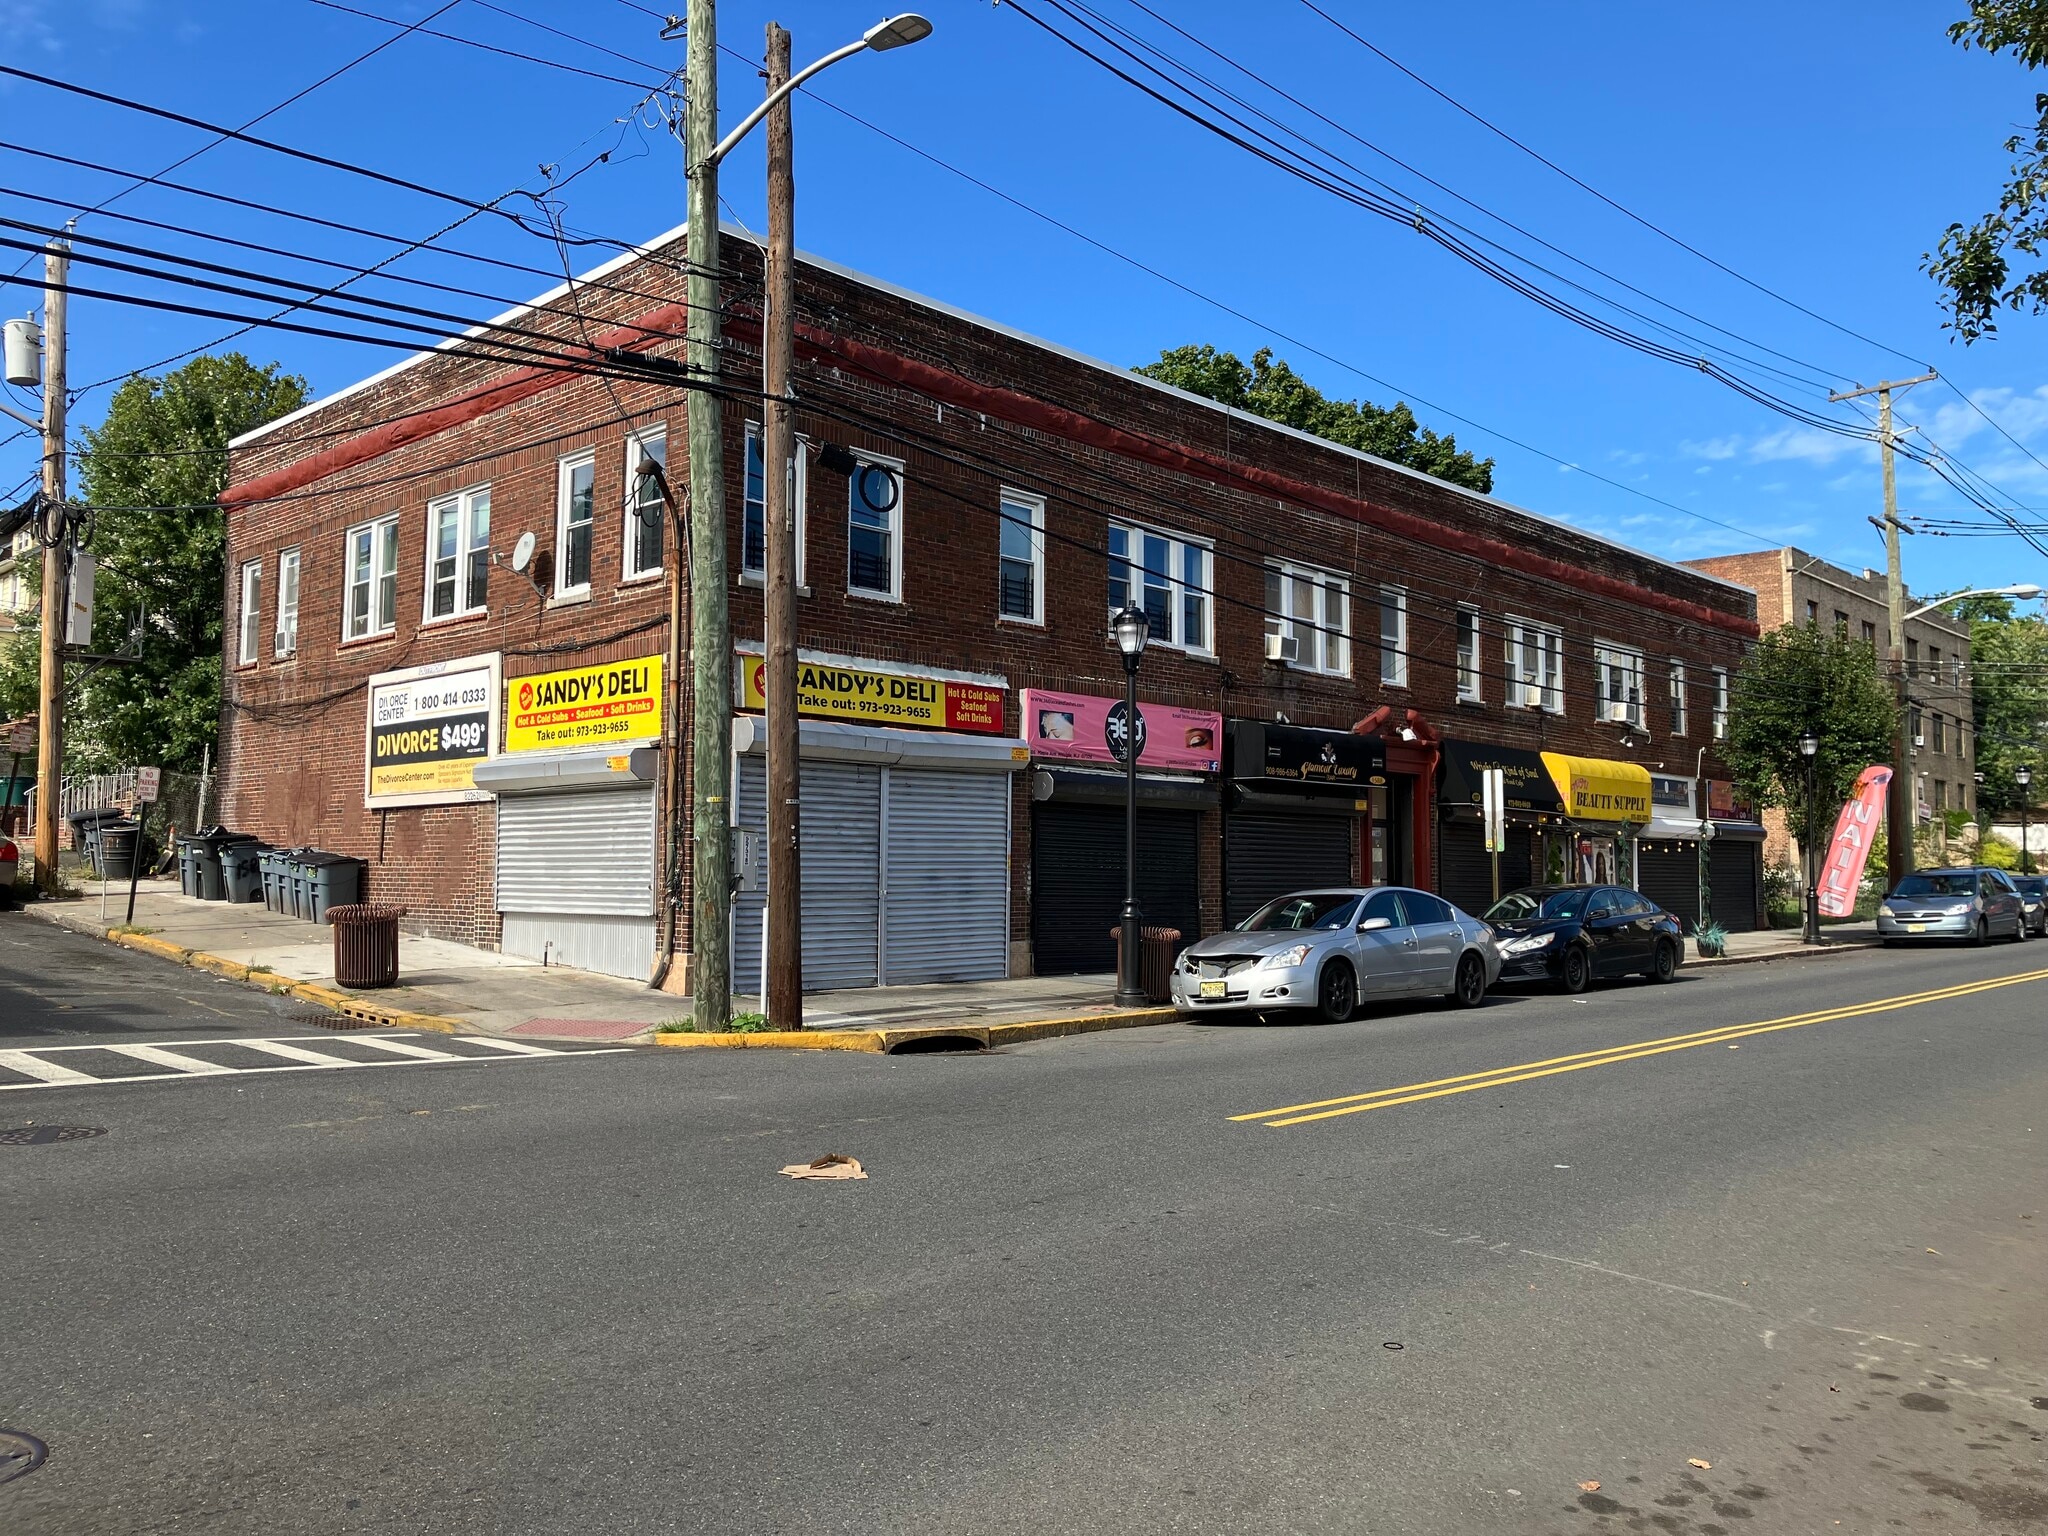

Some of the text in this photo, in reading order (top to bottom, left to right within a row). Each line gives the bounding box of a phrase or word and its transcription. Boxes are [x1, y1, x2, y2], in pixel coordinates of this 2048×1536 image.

[536, 667, 648, 707] SANDY'S DELI
[797, 668, 936, 703] ANDY'S DELI
[947, 687, 1000, 703] Hot & Cold Subs
[378, 707, 404, 721] CENTER
[517, 700, 651, 726] Hot & Cold Subs Seafood Soft Drinks
[797, 693, 931, 718] Take out: 973-923-9655
[960, 701, 987, 712] Seafood
[956, 711, 992, 724] Soft Drinks
[537, 721, 629, 742] Take out: 973-923-9655
[376, 728, 439, 757] DIVORCE
[377, 773, 435, 784] TheDivorceCenter.com
[1301, 761, 1332, 780] Glamour
[1333, 764, 1358, 779] Luxury
[1576, 792, 1613, 809] BEAUTY
[1614, 795, 1647, 812] SUPPLY
[1818, 800, 1873, 915] NAILS
